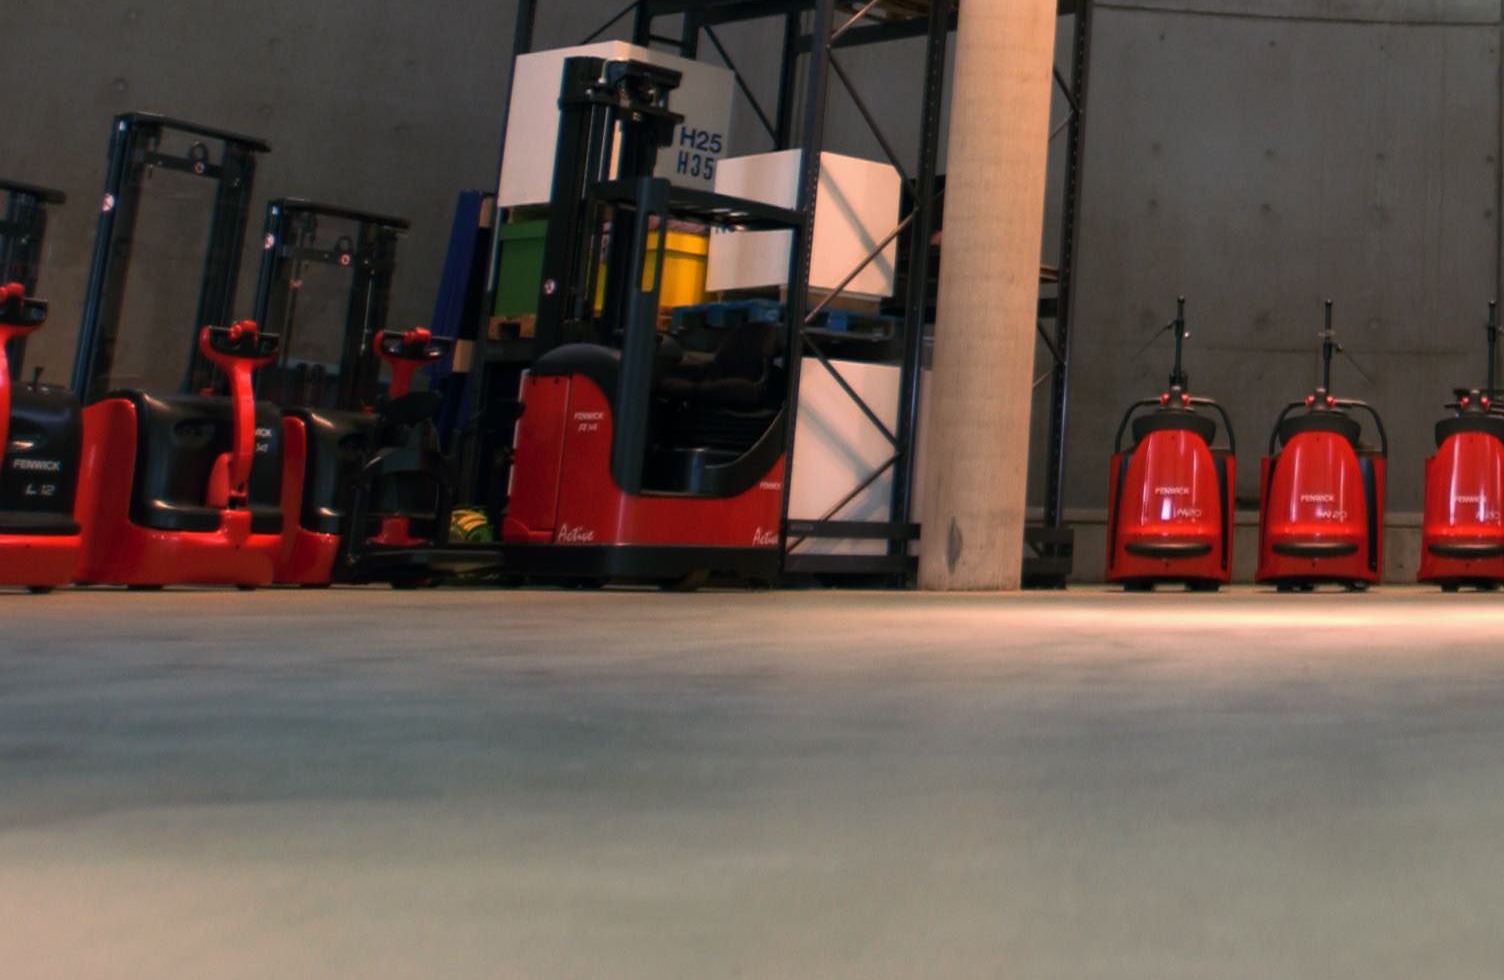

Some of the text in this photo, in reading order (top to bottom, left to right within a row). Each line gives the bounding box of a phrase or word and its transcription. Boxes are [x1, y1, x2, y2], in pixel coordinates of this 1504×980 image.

[680, 126, 722, 153] H25
[676, 151, 714, 180] H35
[13, 459, 61, 471] FENWICK
[1154, 487, 1190, 495] FENWICK
[1300, 494, 1335, 503] FENWICK
[558, 522, 595, 542] Active
